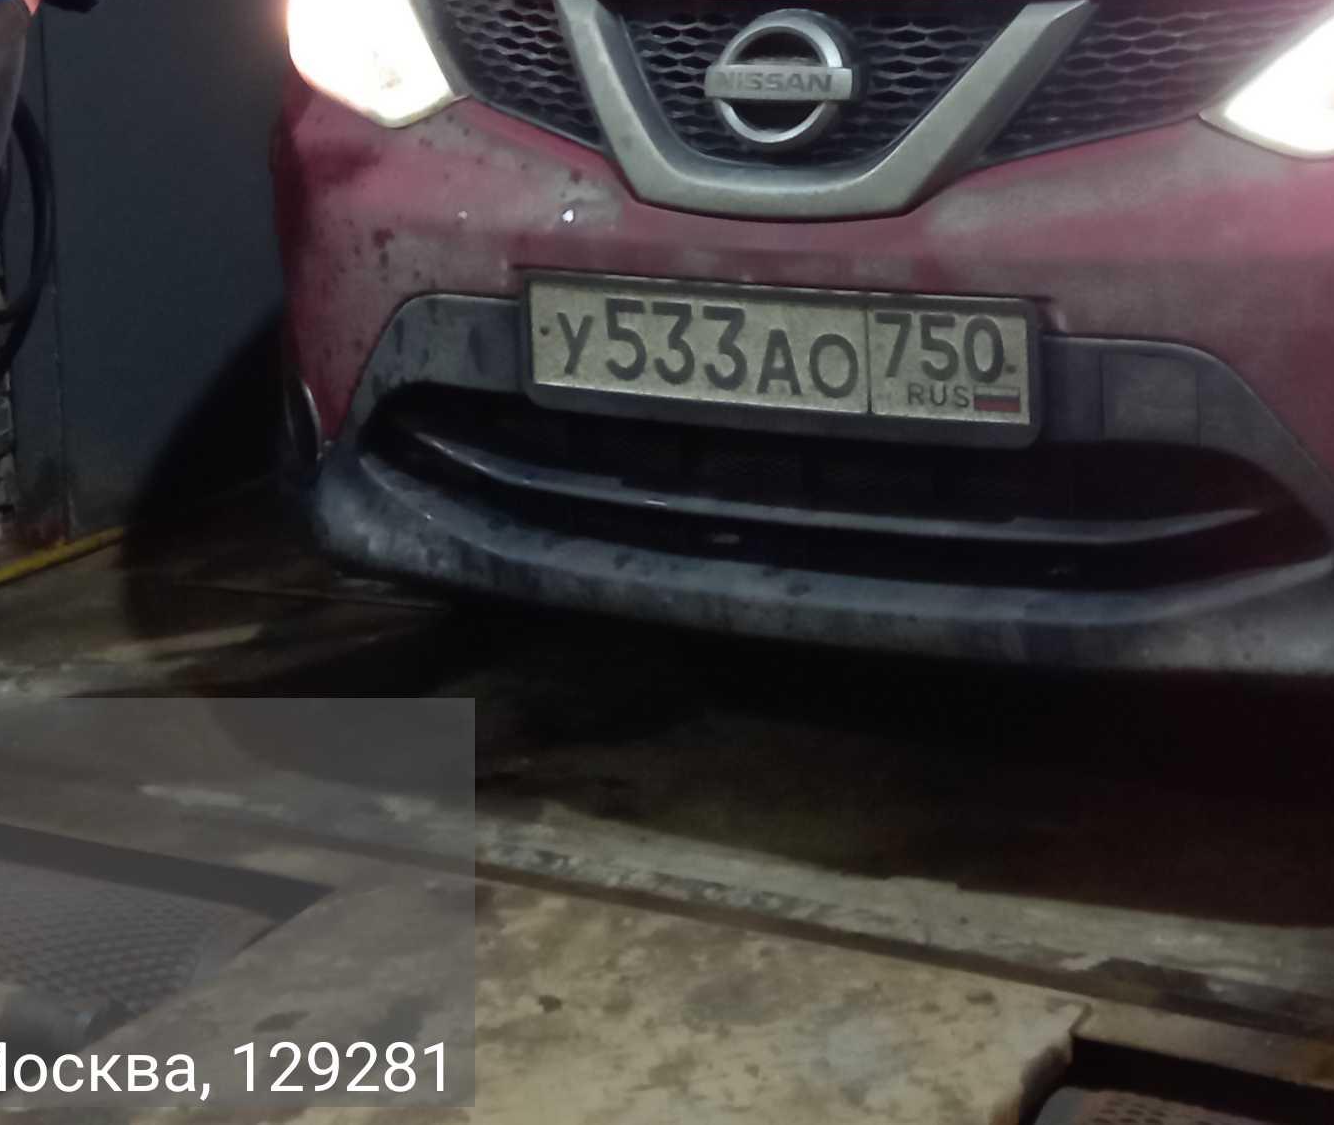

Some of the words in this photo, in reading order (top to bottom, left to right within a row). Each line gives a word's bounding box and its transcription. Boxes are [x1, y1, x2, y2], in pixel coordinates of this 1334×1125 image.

[712, 70, 833, 94] NISSAN
[874, 311, 1004, 383] 750
[907, 383, 971, 409] RUS
